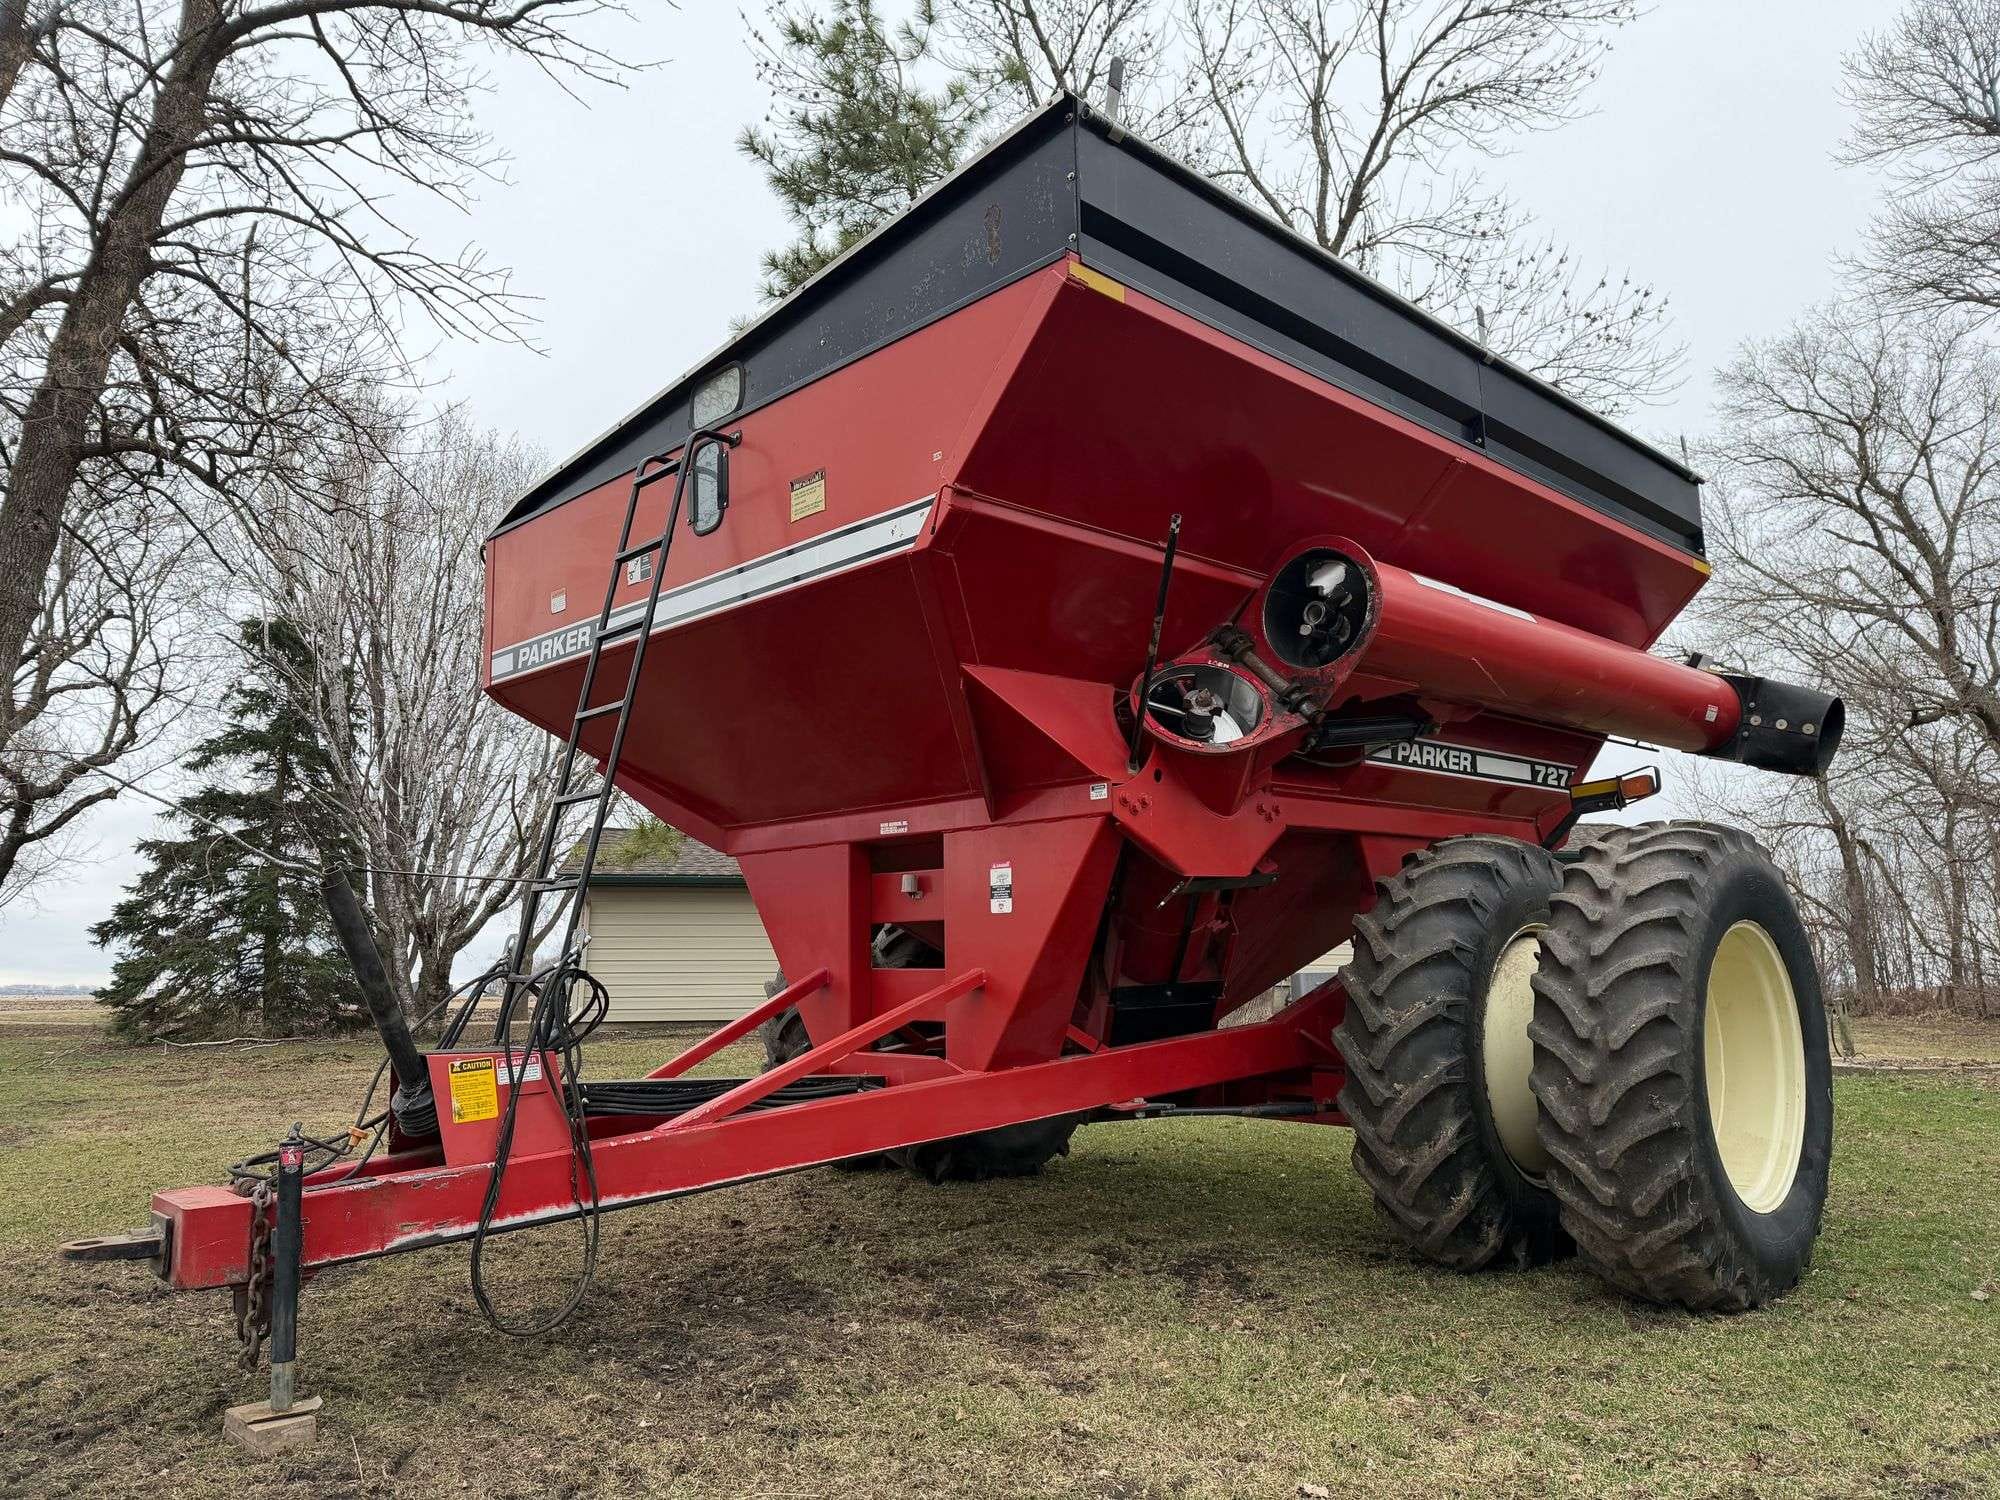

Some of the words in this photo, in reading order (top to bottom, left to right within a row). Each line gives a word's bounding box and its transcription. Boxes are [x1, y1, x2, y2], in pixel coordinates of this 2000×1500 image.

[518, 625, 591, 669] PARKER
[1397, 742, 1472, 773] PARKER
[1534, 765, 1568, 787] 727
[462, 1060, 491, 1070] CAUTION
